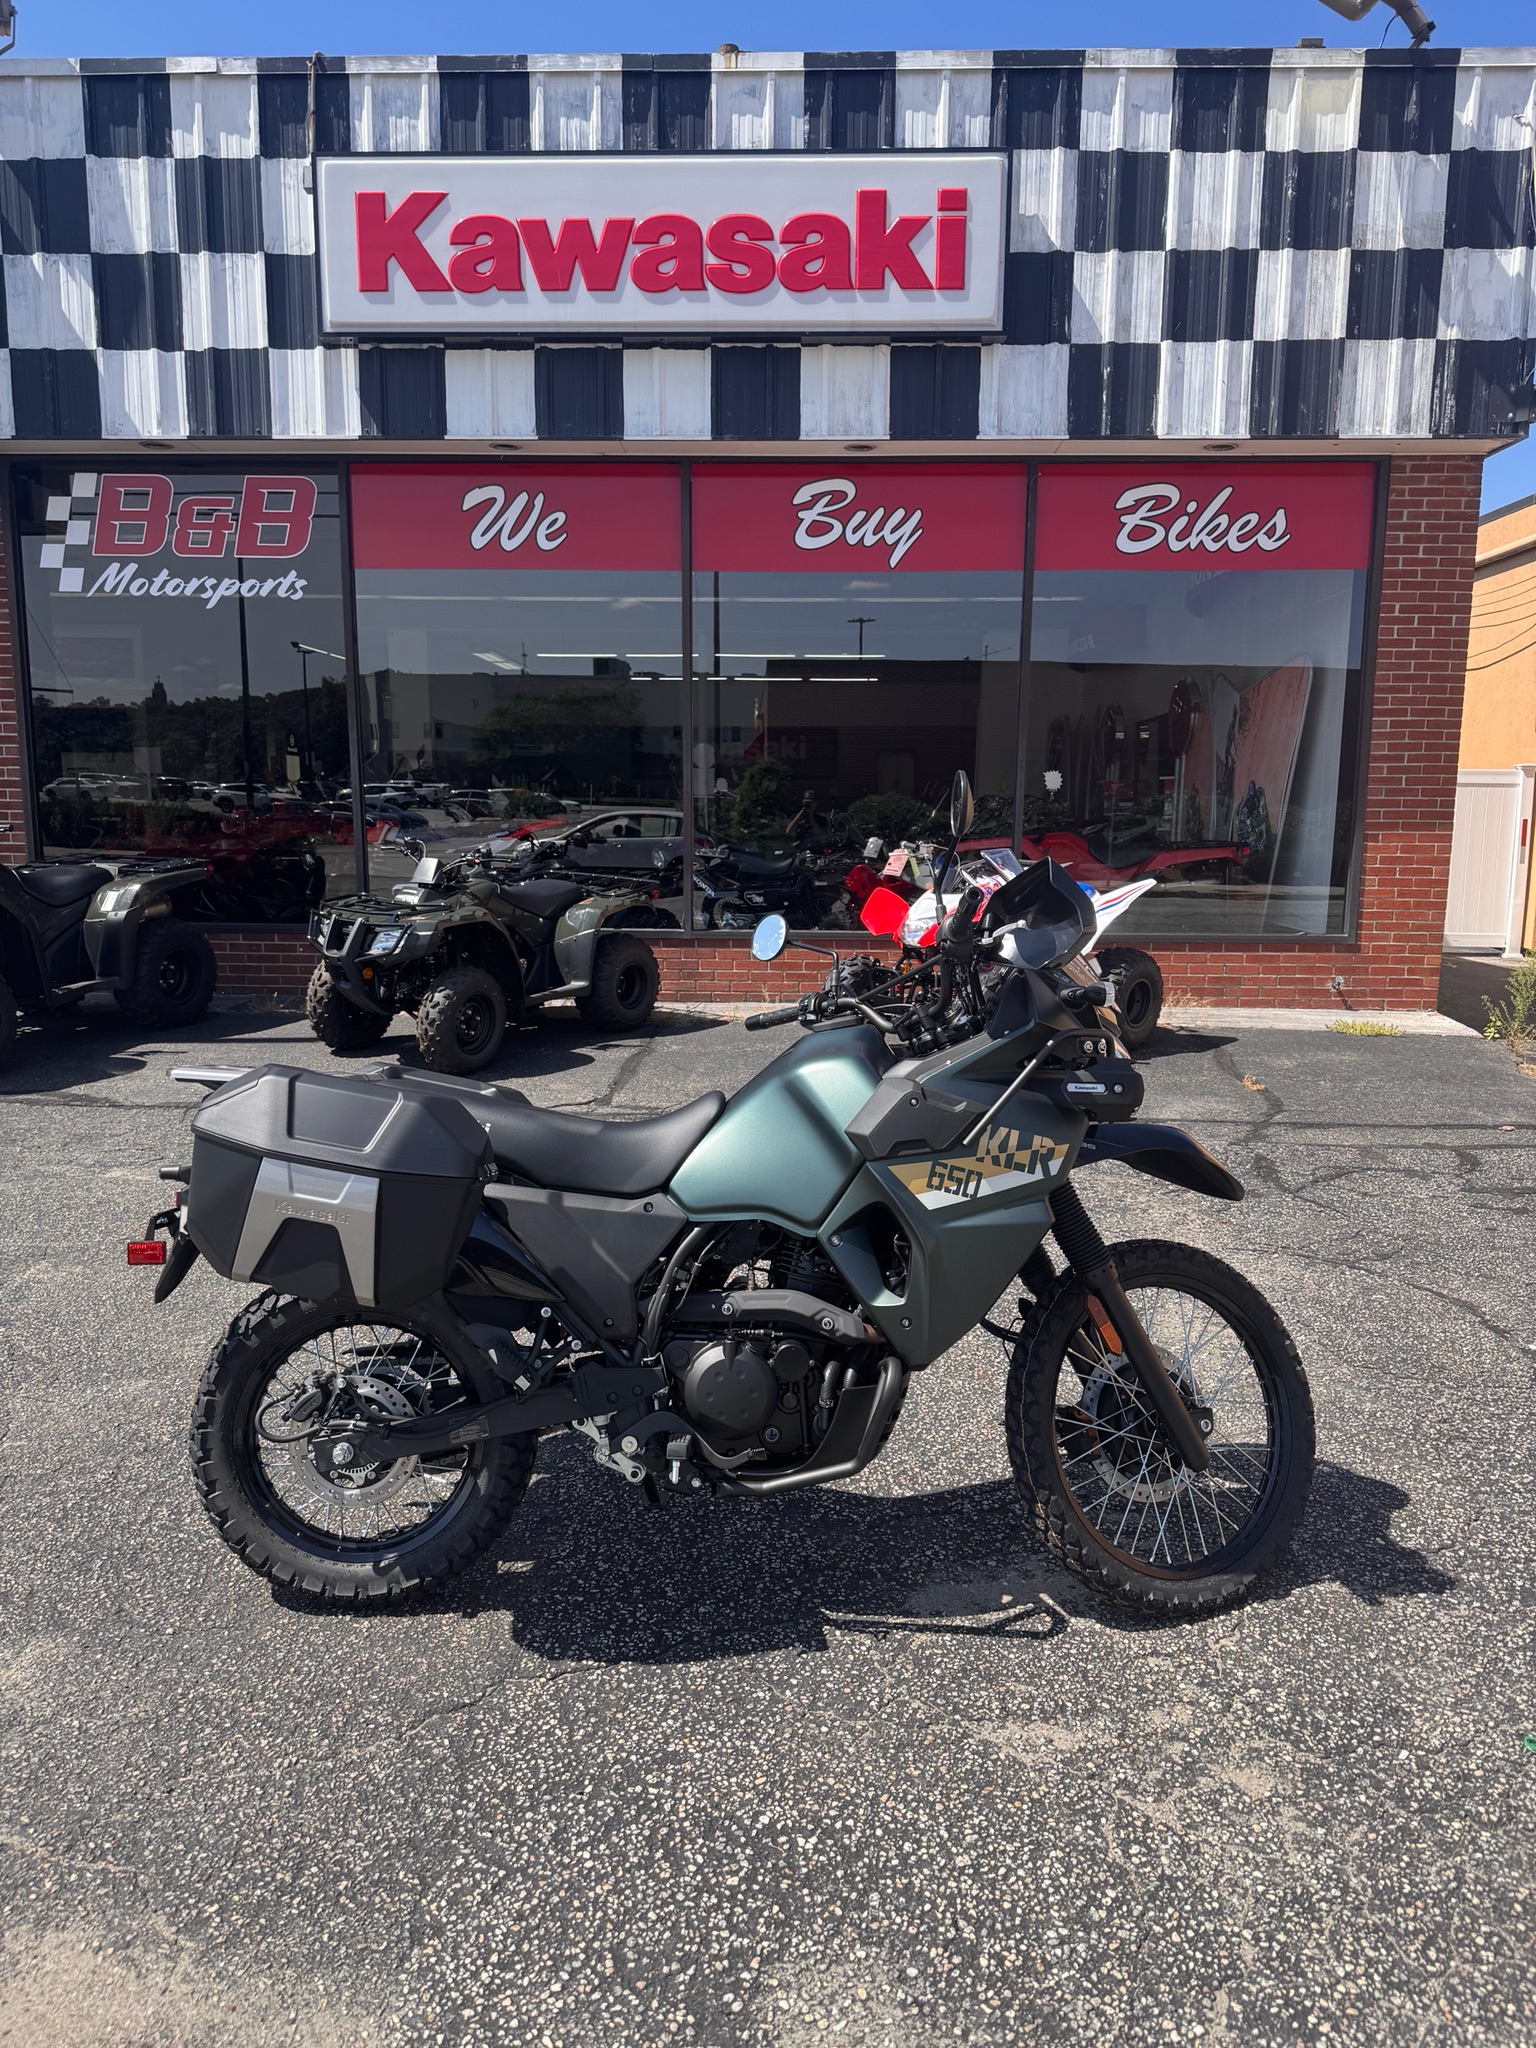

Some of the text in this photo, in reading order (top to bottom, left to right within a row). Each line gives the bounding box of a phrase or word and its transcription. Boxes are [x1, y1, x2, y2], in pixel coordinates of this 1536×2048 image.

[354, 188, 967, 294] Kawasaki
[92, 474, 318, 559] B&B
[461, 477, 1291, 569] We Buy Bikes
[87, 562, 308, 610] Motorsports
[975, 1124, 1056, 1178] KLR
[926, 1159, 983, 1198] 650
[274, 1199, 351, 1225] Kawasaki
